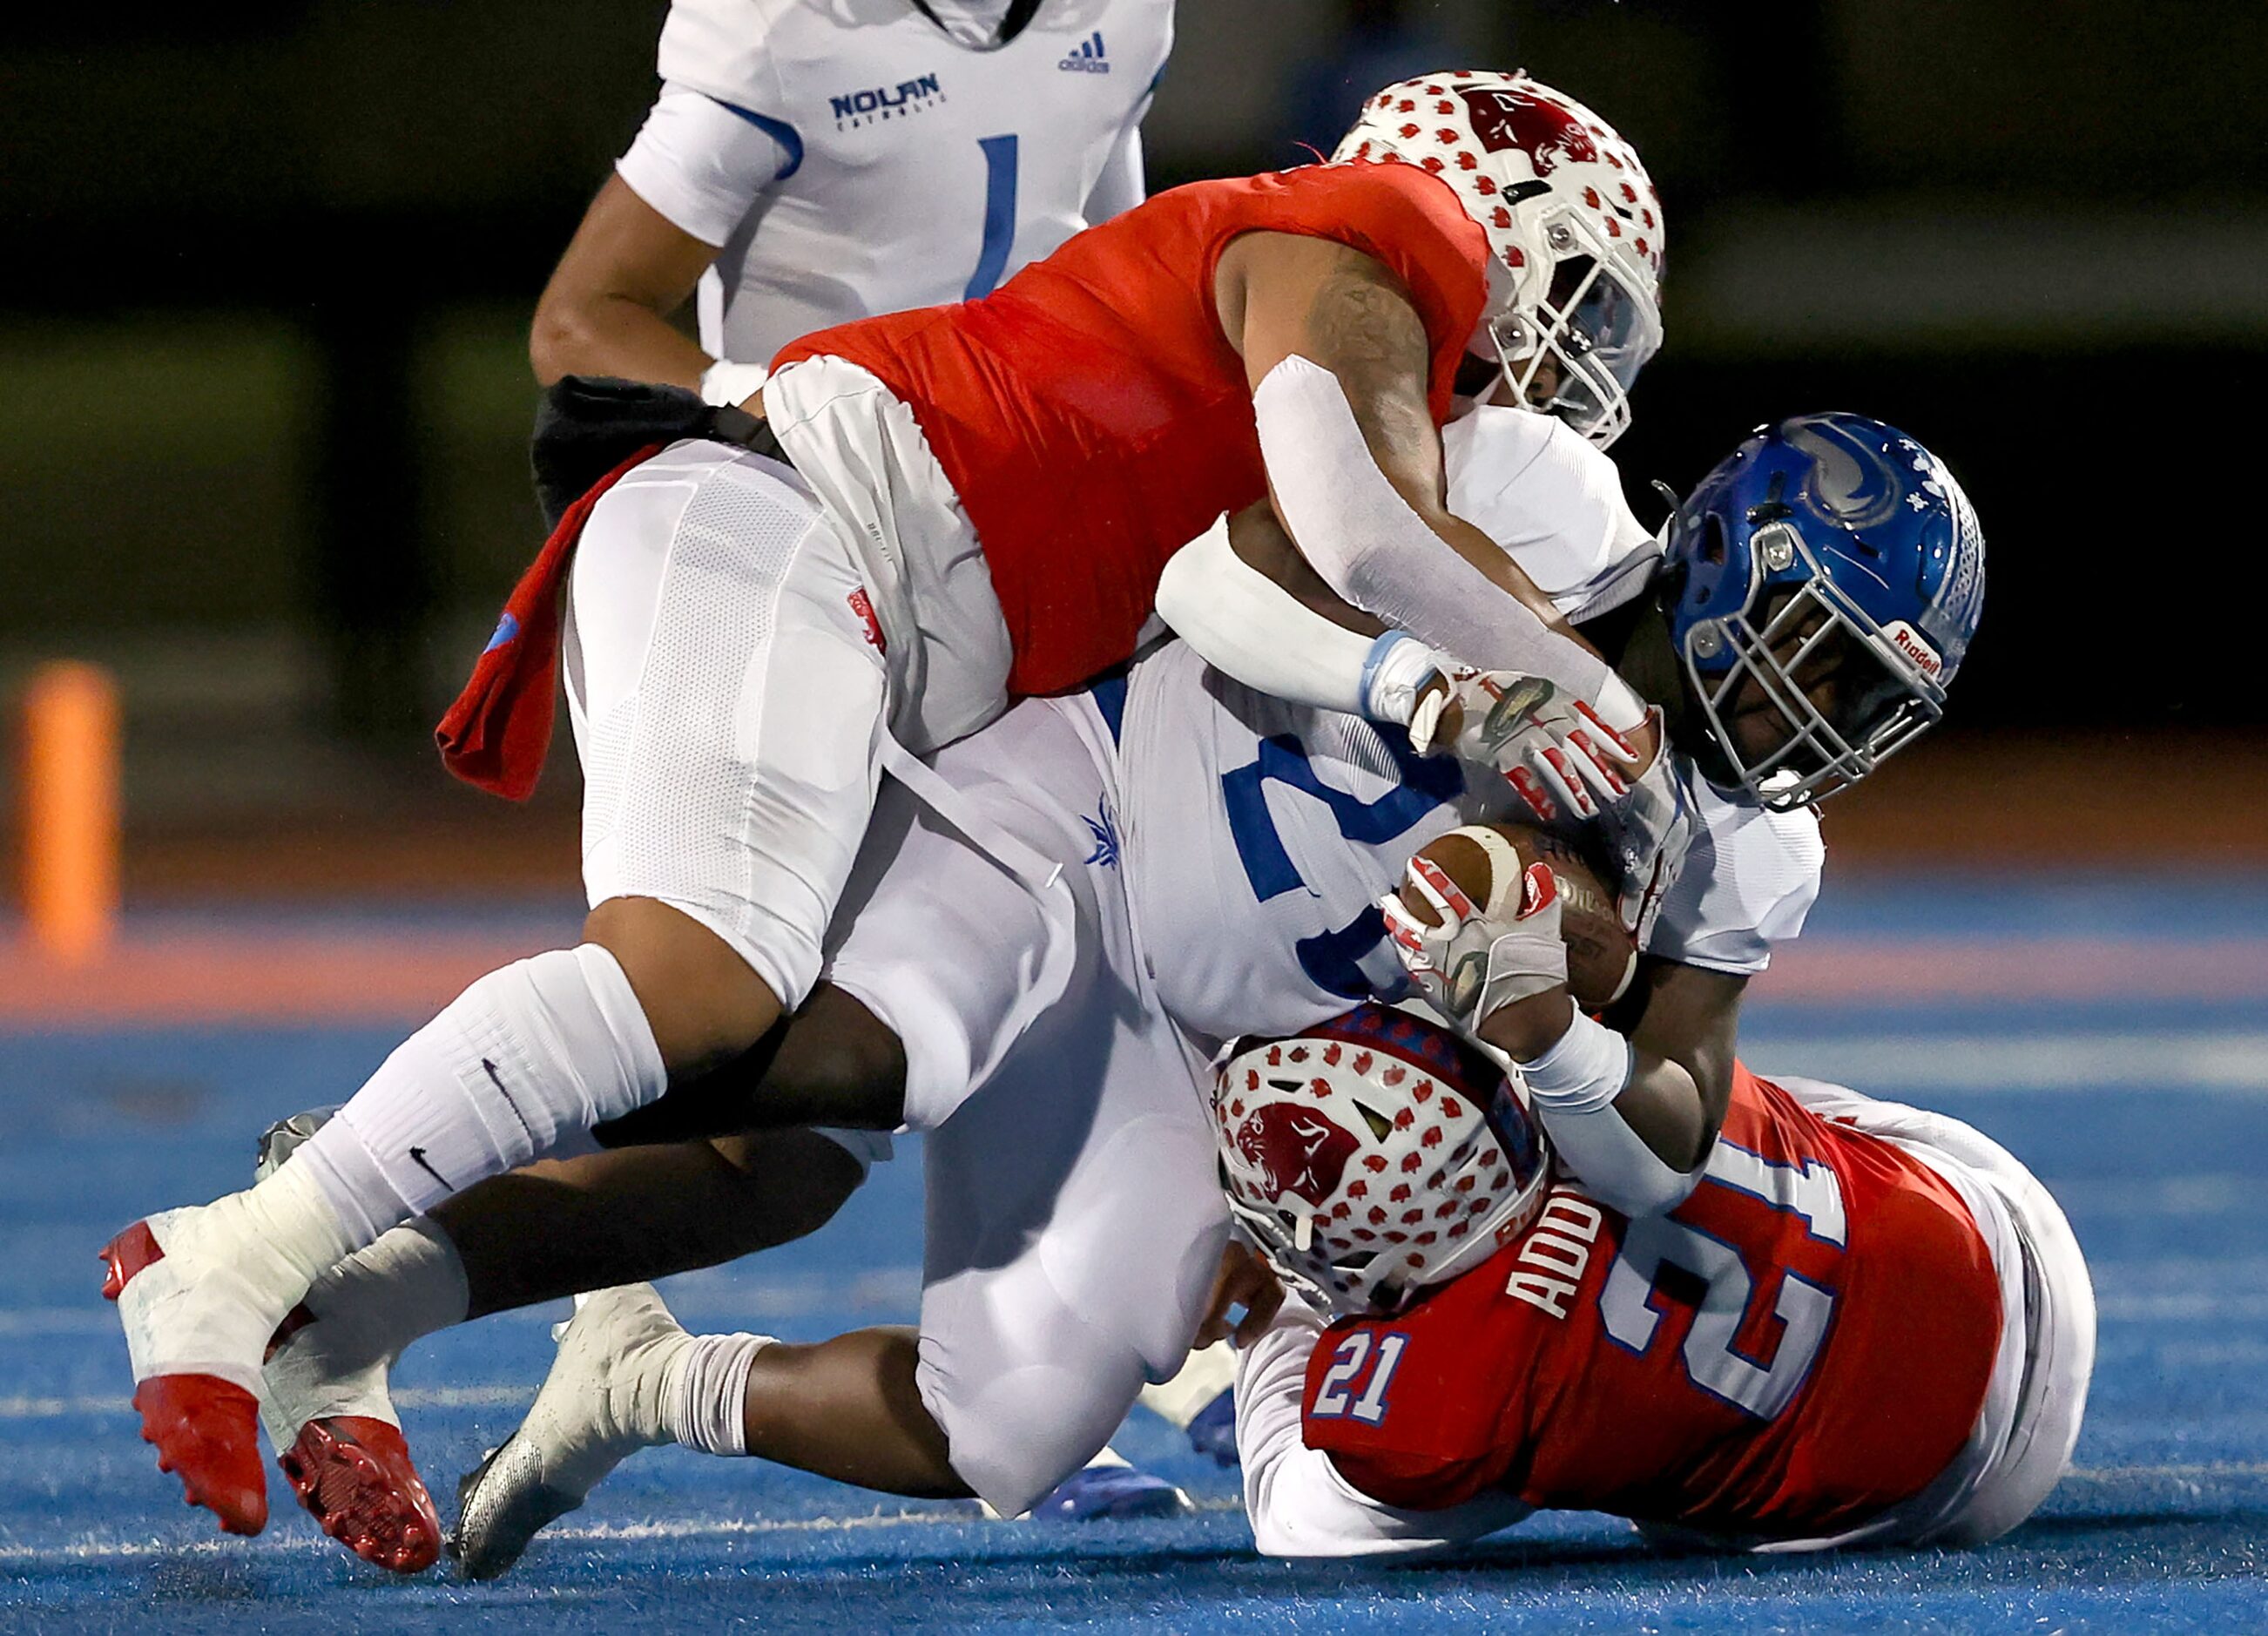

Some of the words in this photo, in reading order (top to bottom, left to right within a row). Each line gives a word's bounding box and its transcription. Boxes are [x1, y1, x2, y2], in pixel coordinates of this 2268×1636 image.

[829, 72, 940, 118] NOLAN
[1057, 58, 1110, 73] adidas
[964, 133, 1019, 302] 1
[1505, 1185, 1602, 1320] ADD
[1597, 1134, 1848, 1423] 21
[1309, 1329, 1413, 1428] 21
